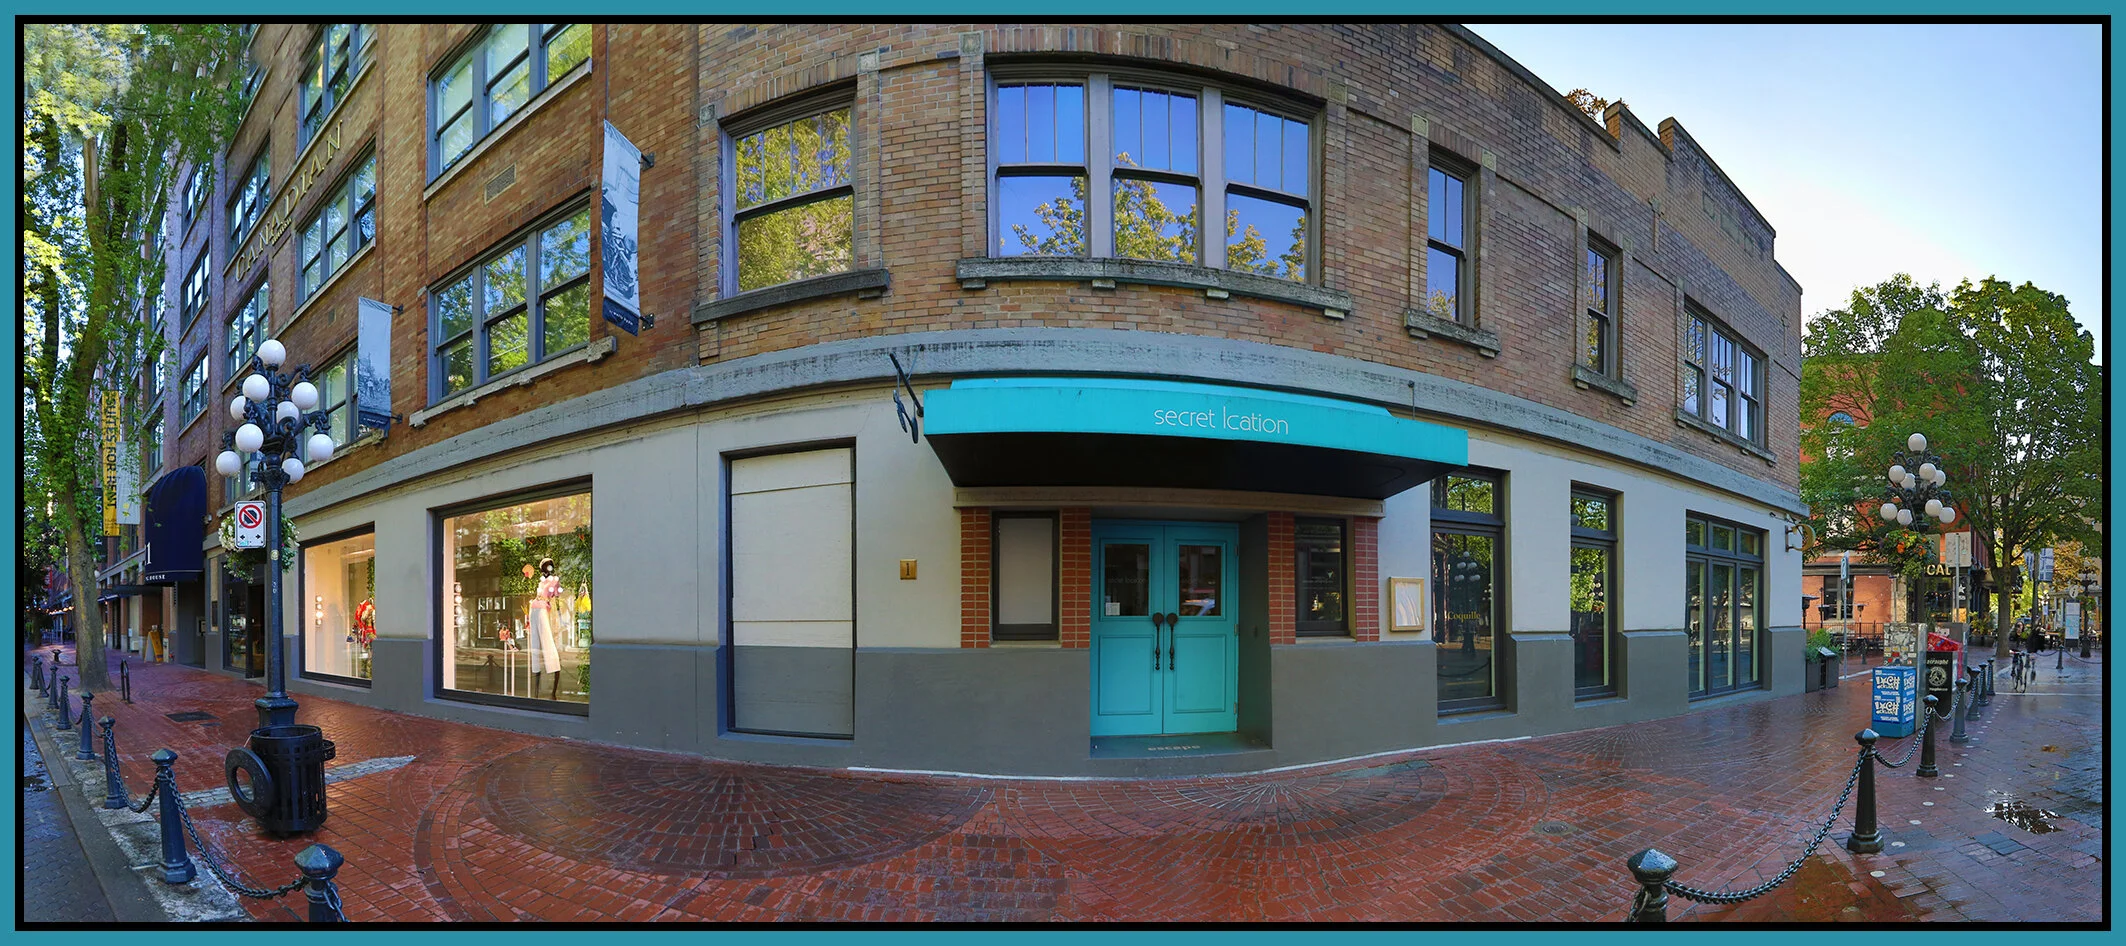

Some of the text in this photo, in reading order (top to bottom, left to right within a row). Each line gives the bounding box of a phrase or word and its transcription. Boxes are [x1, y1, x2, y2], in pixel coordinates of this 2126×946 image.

[236, 119, 343, 282] CANADIAN
[105, 398, 117, 443] SUITES
[1154, 409, 1216, 429] secret
[106, 446, 117, 472] FOR
[106, 475, 117, 510] RENT
[1924, 564, 1952, 576] CAL
[1447, 611, 1481, 623] Coquille
